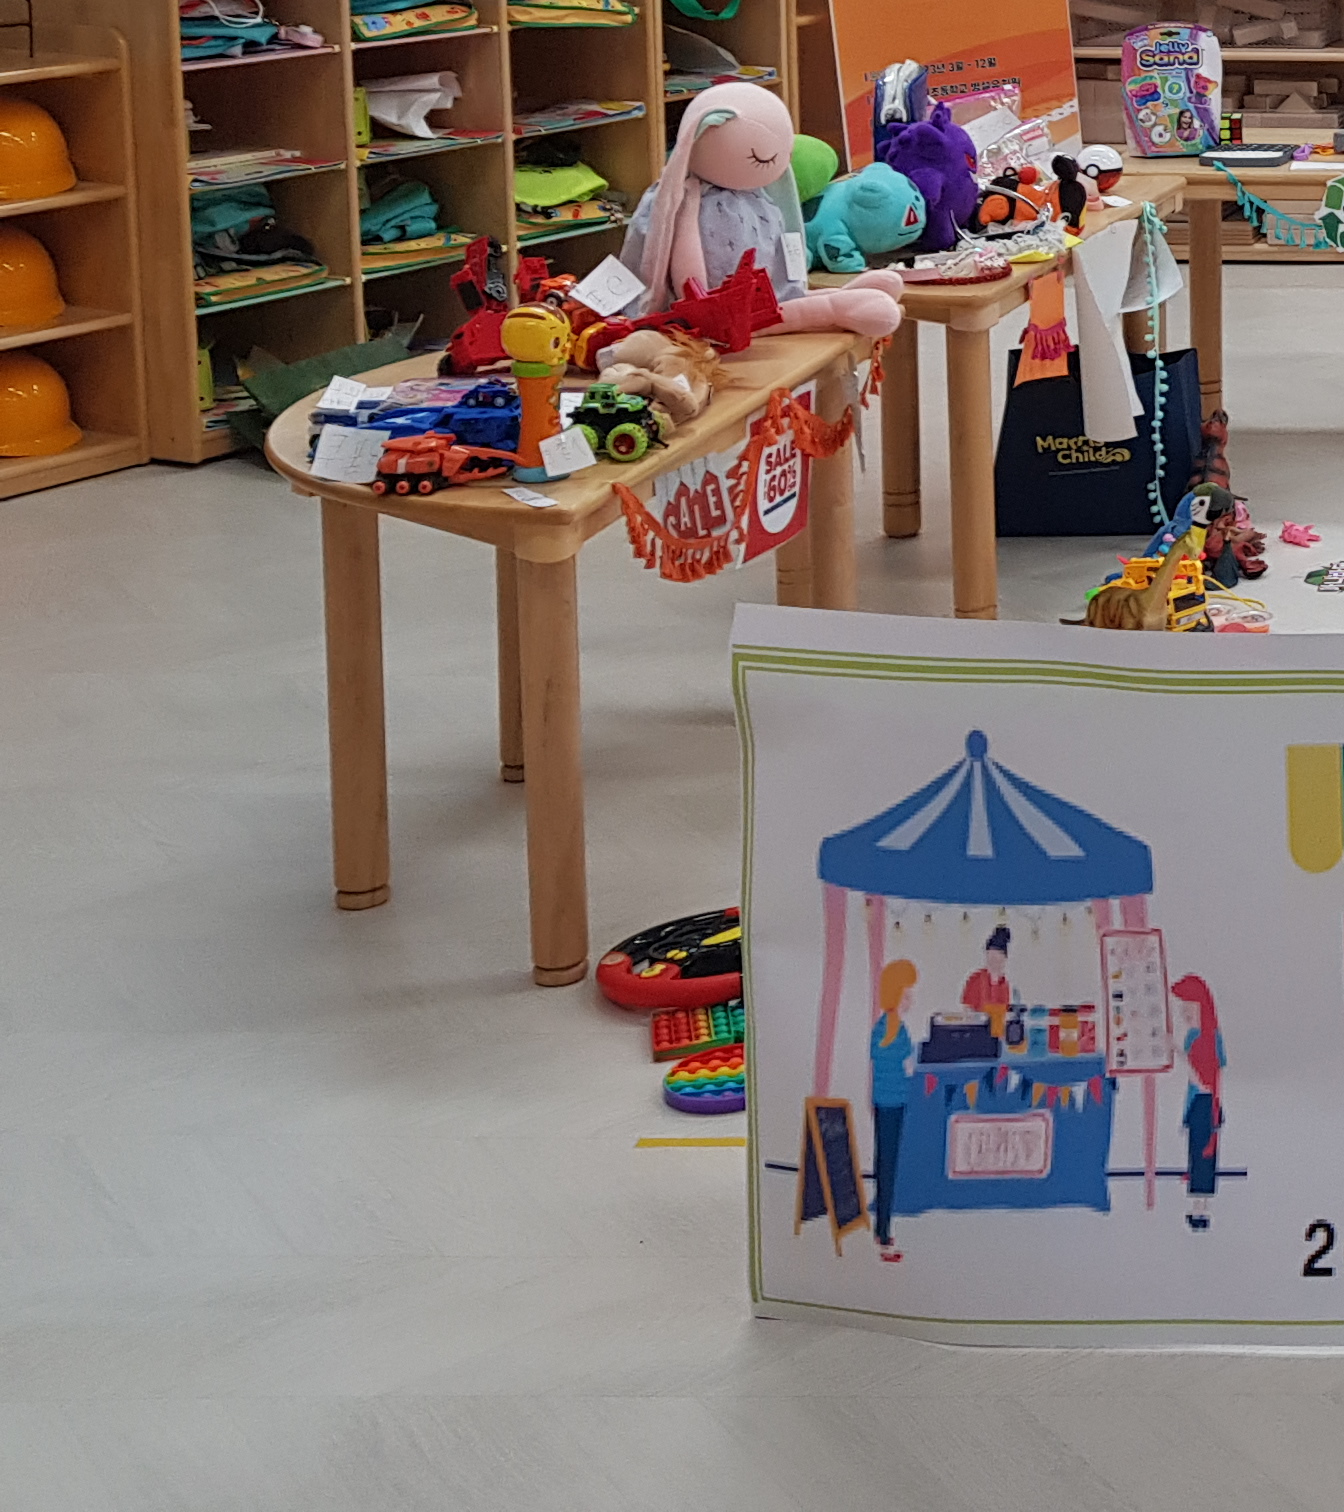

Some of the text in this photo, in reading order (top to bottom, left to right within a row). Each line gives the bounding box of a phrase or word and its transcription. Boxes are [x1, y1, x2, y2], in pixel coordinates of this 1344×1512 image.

[1154, 41, 1190, 54] Jelly
[1139, 48, 1200, 68] Sand
[928, 82, 968, 97] 초등학교
[765, 439, 797, 475] SALE
[1057, 447, 1107, 464] Child
[666, 484, 721, 538] SALE
